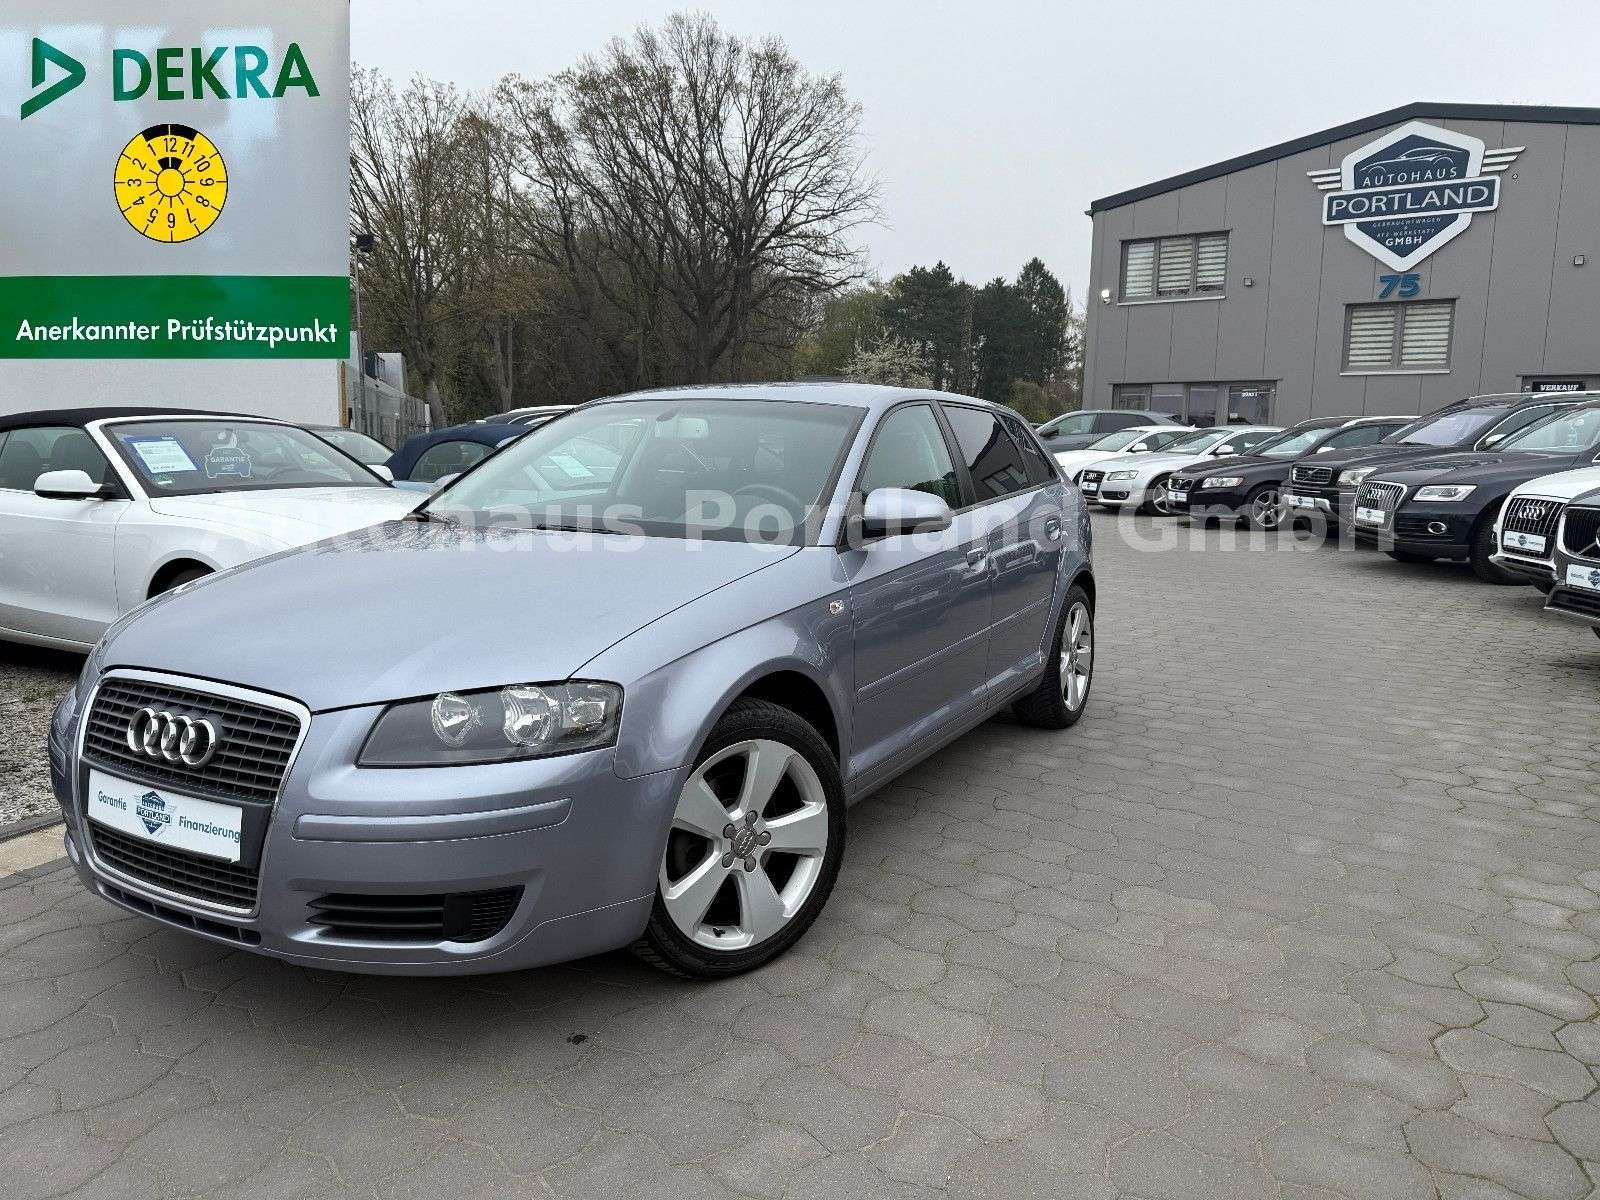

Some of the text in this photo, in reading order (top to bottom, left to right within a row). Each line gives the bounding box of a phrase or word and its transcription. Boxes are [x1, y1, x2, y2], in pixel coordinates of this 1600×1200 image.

[113, 42, 320, 101] DEKRA
[147, 143, 156, 156] 1
[163, 137, 177, 152] 12
[182, 141, 195, 158] 11
[132, 157, 147, 170] 2
[194, 154, 211, 172] 10
[127, 178, 142, 187] 3
[199, 177, 215, 187] 9
[1362, 166, 1457, 187] AUTOHAUS
[132, 195, 145, 206] 4
[195, 195, 210, 207] 8
[1332, 186, 1489, 216] PORTLAND
[147, 208, 158, 223] 5
[187, 208, 196, 223] 7
[1385, 236, 1423, 247] GMBH
[1379, 273, 1421, 299] 75
[16, 317, 338, 348] Anerkannter Prüfstützpunkt
[1540, 384, 1579, 392] VERKAUF
[210, 455, 246, 463] GARANTIE
[98, 791, 127, 811] Garantie
[178, 815, 241, 842] Finanzierung
